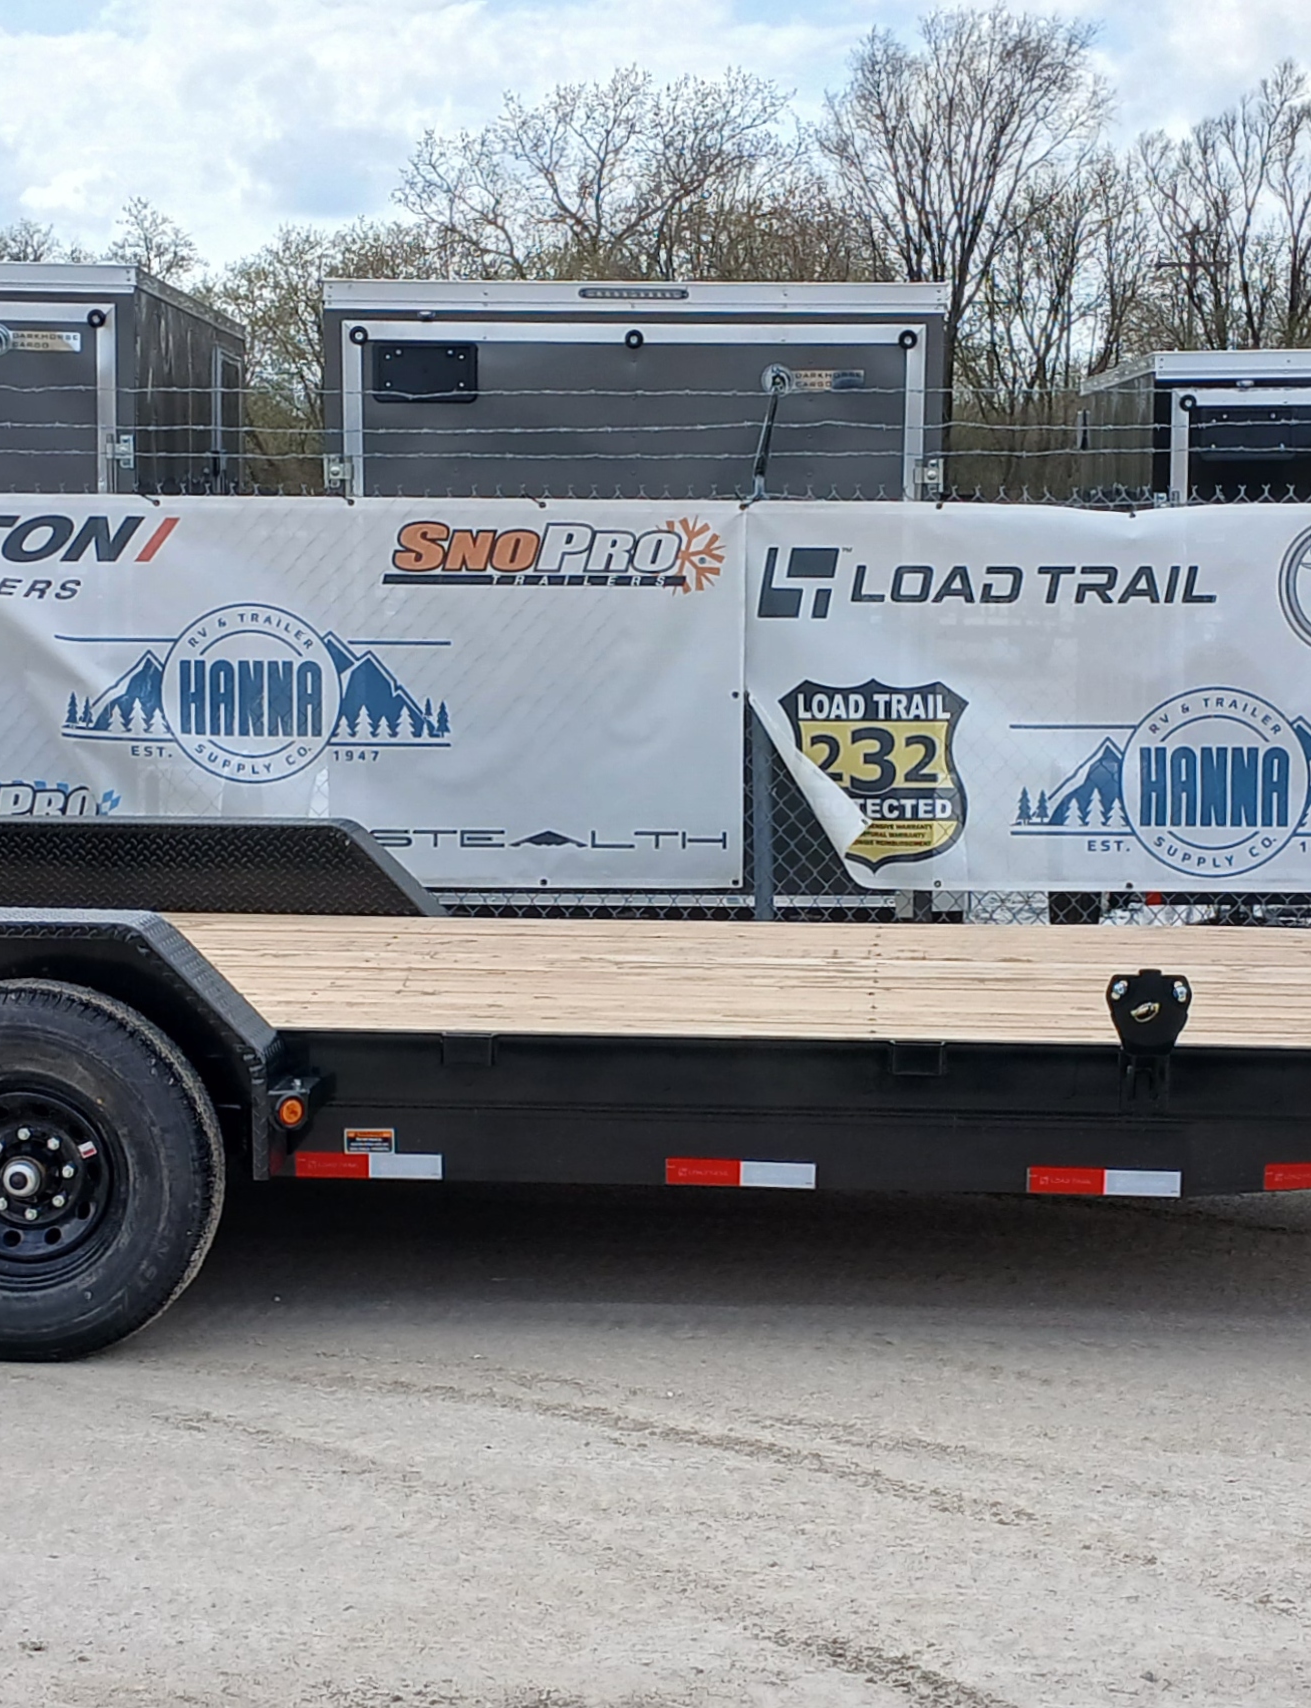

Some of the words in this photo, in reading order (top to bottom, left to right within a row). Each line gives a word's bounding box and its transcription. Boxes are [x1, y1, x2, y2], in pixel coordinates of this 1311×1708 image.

[492, 575, 667, 587] TRAILERS
[851, 565, 1023, 603] LOAD
[1037, 565, 1217, 604] TRAIL
[188, 627, 208, 648] RV
[237, 613, 314, 650] TRAILER
[179, 659, 323, 737] HANNA
[797, 693, 865, 719] LOAD
[873, 693, 951, 720] TRAIL
[1149, 714, 1170, 734] RV
[1202, 698, 1282, 735] TRAILER
[131, 745, 173, 758] EST.
[194, 743, 273, 775] SUPPLY
[333, 750, 380, 762] 1947
[810, 727, 939, 793] 232
[1139, 746, 1290, 827] HANNA
[852, 798, 953, 819] ECTED
[369, 829, 728, 849] STEALTH
[1087, 840, 1131, 852] EST.
[1153, 835, 1234, 868] SUPPLY
